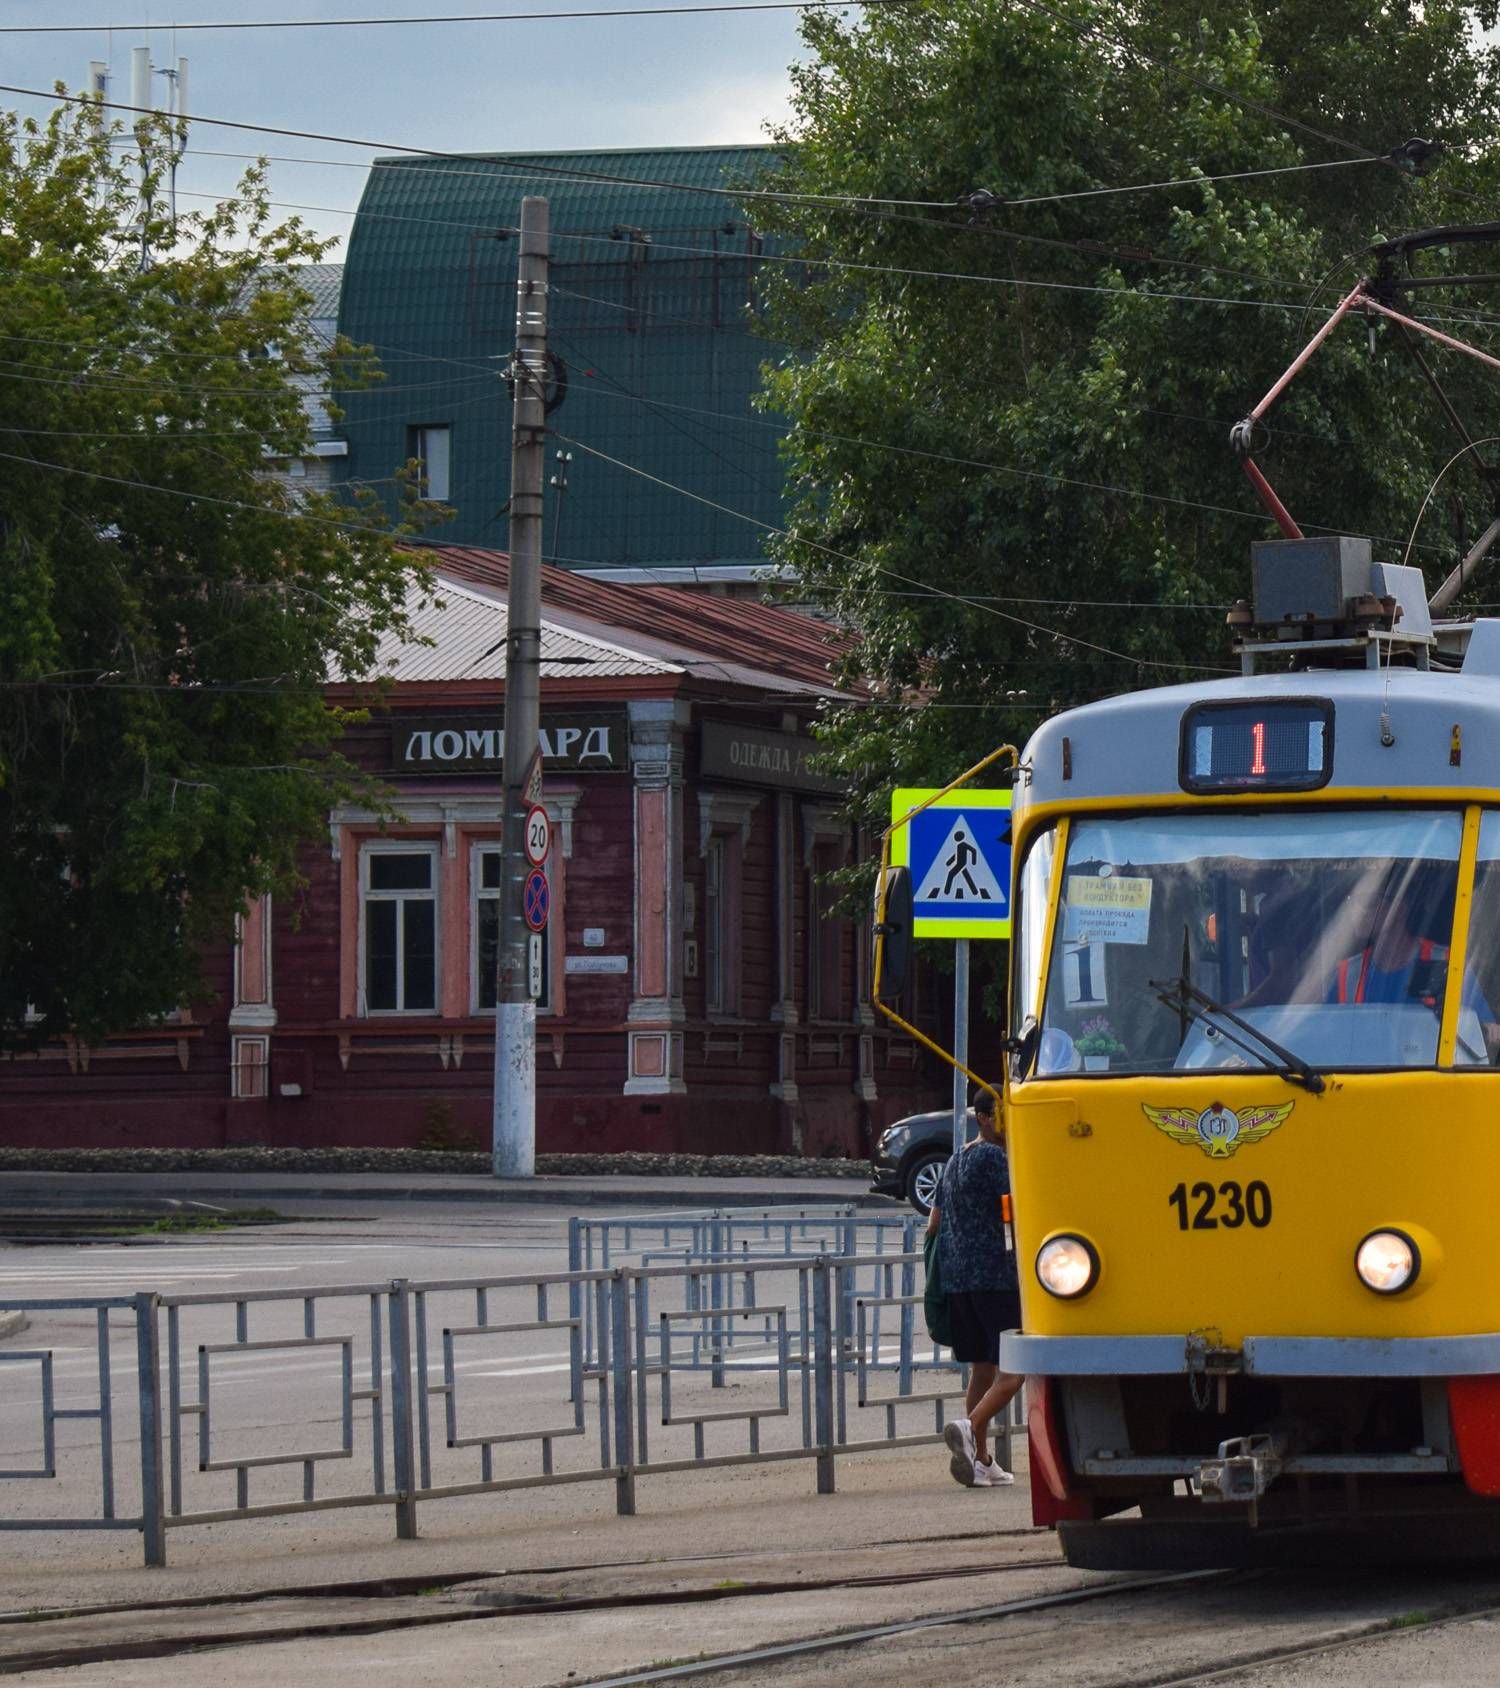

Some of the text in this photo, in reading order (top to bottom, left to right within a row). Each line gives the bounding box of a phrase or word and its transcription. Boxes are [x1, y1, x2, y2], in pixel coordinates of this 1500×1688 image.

[405, 727, 613, 764] ЛОМАРД
[730, 741, 790, 774] ОДЕЖДА
[1252, 723, 1265, 774] 1
[530, 823, 546, 848] 20
[1065, 946, 1105, 1003] 1
[1168, 1180, 1272, 1231] 1230
